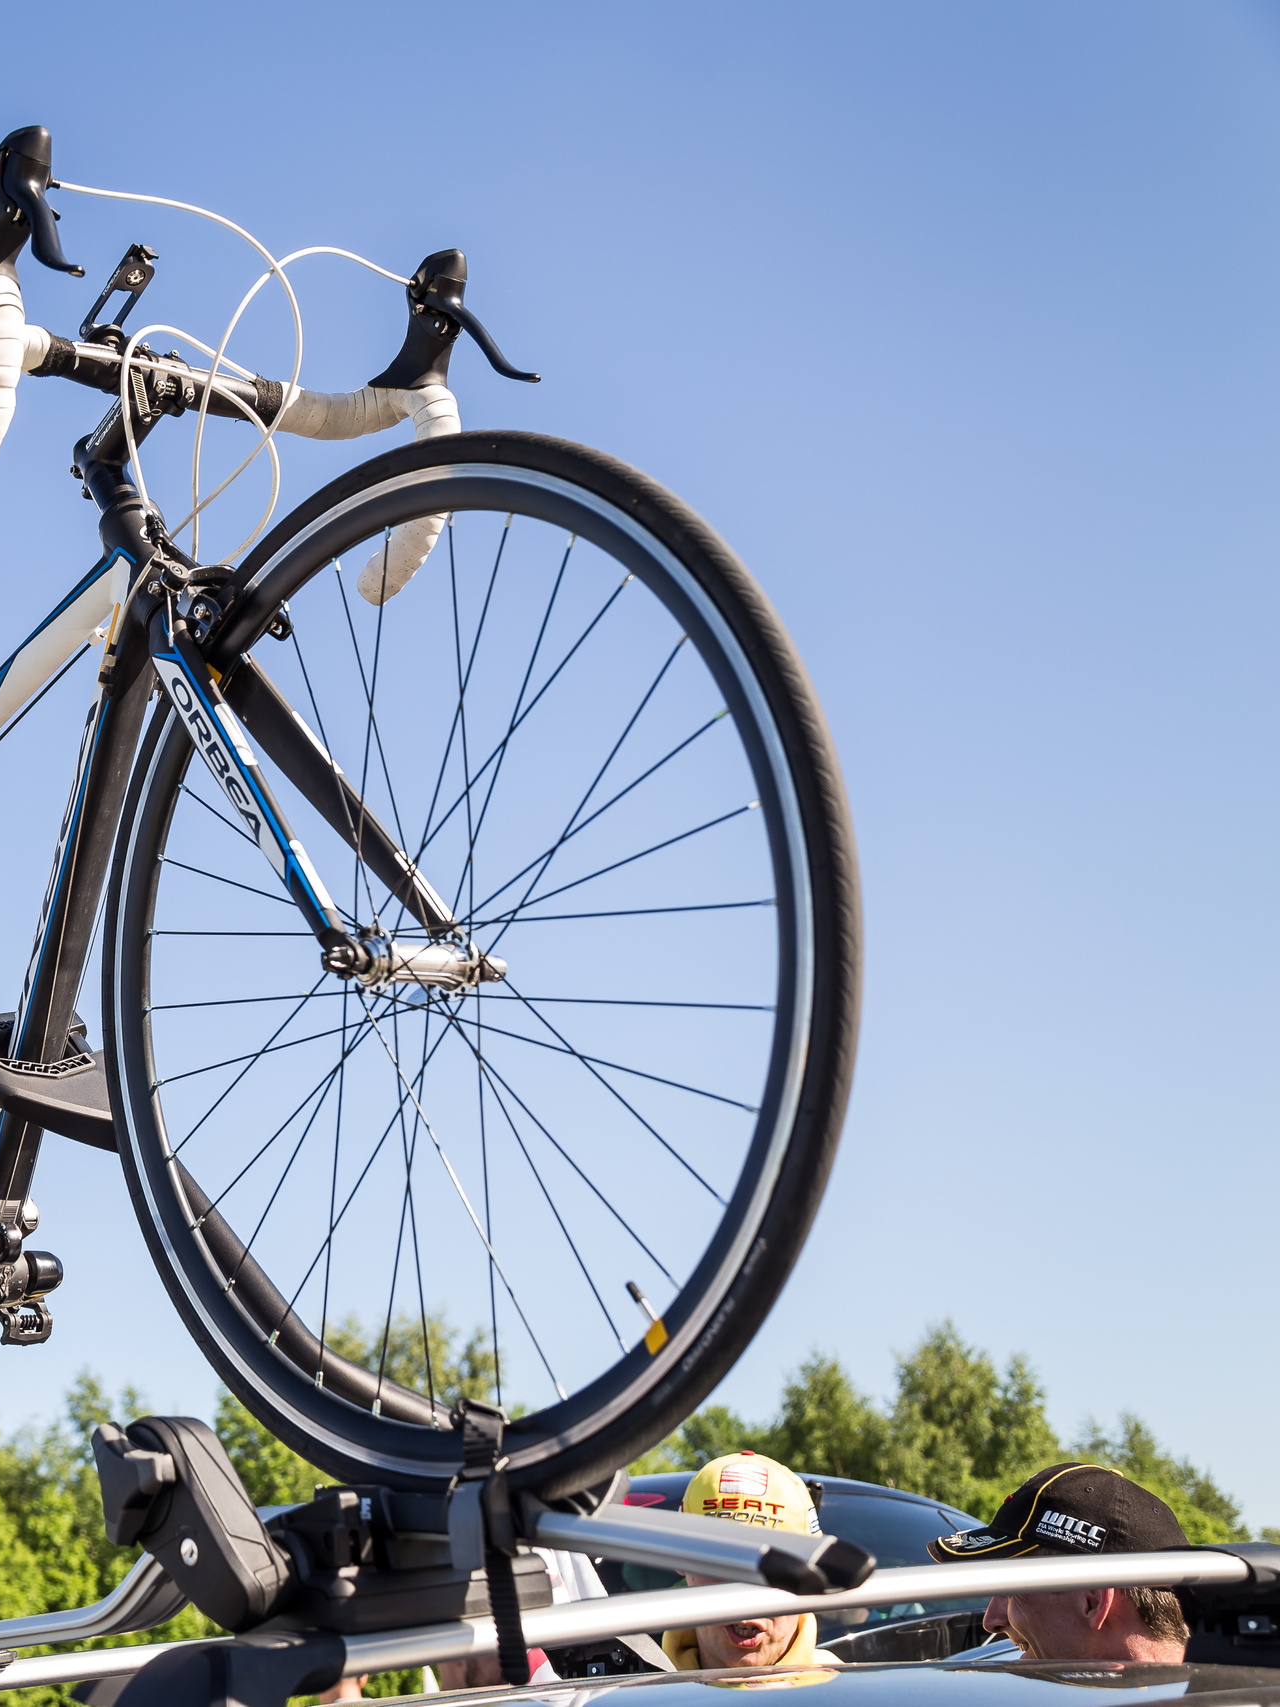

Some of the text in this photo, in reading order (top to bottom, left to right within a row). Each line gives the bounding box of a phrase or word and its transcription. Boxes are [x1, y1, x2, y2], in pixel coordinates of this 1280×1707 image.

[171, 677, 262, 844] ORBEA
[702, 1497, 785, 1515] SEAT
[1041, 1510, 1106, 1541] WTCC
[1065, 1529, 1087, 1544] Touring
[1087, 1538, 1100, 1548] Car
